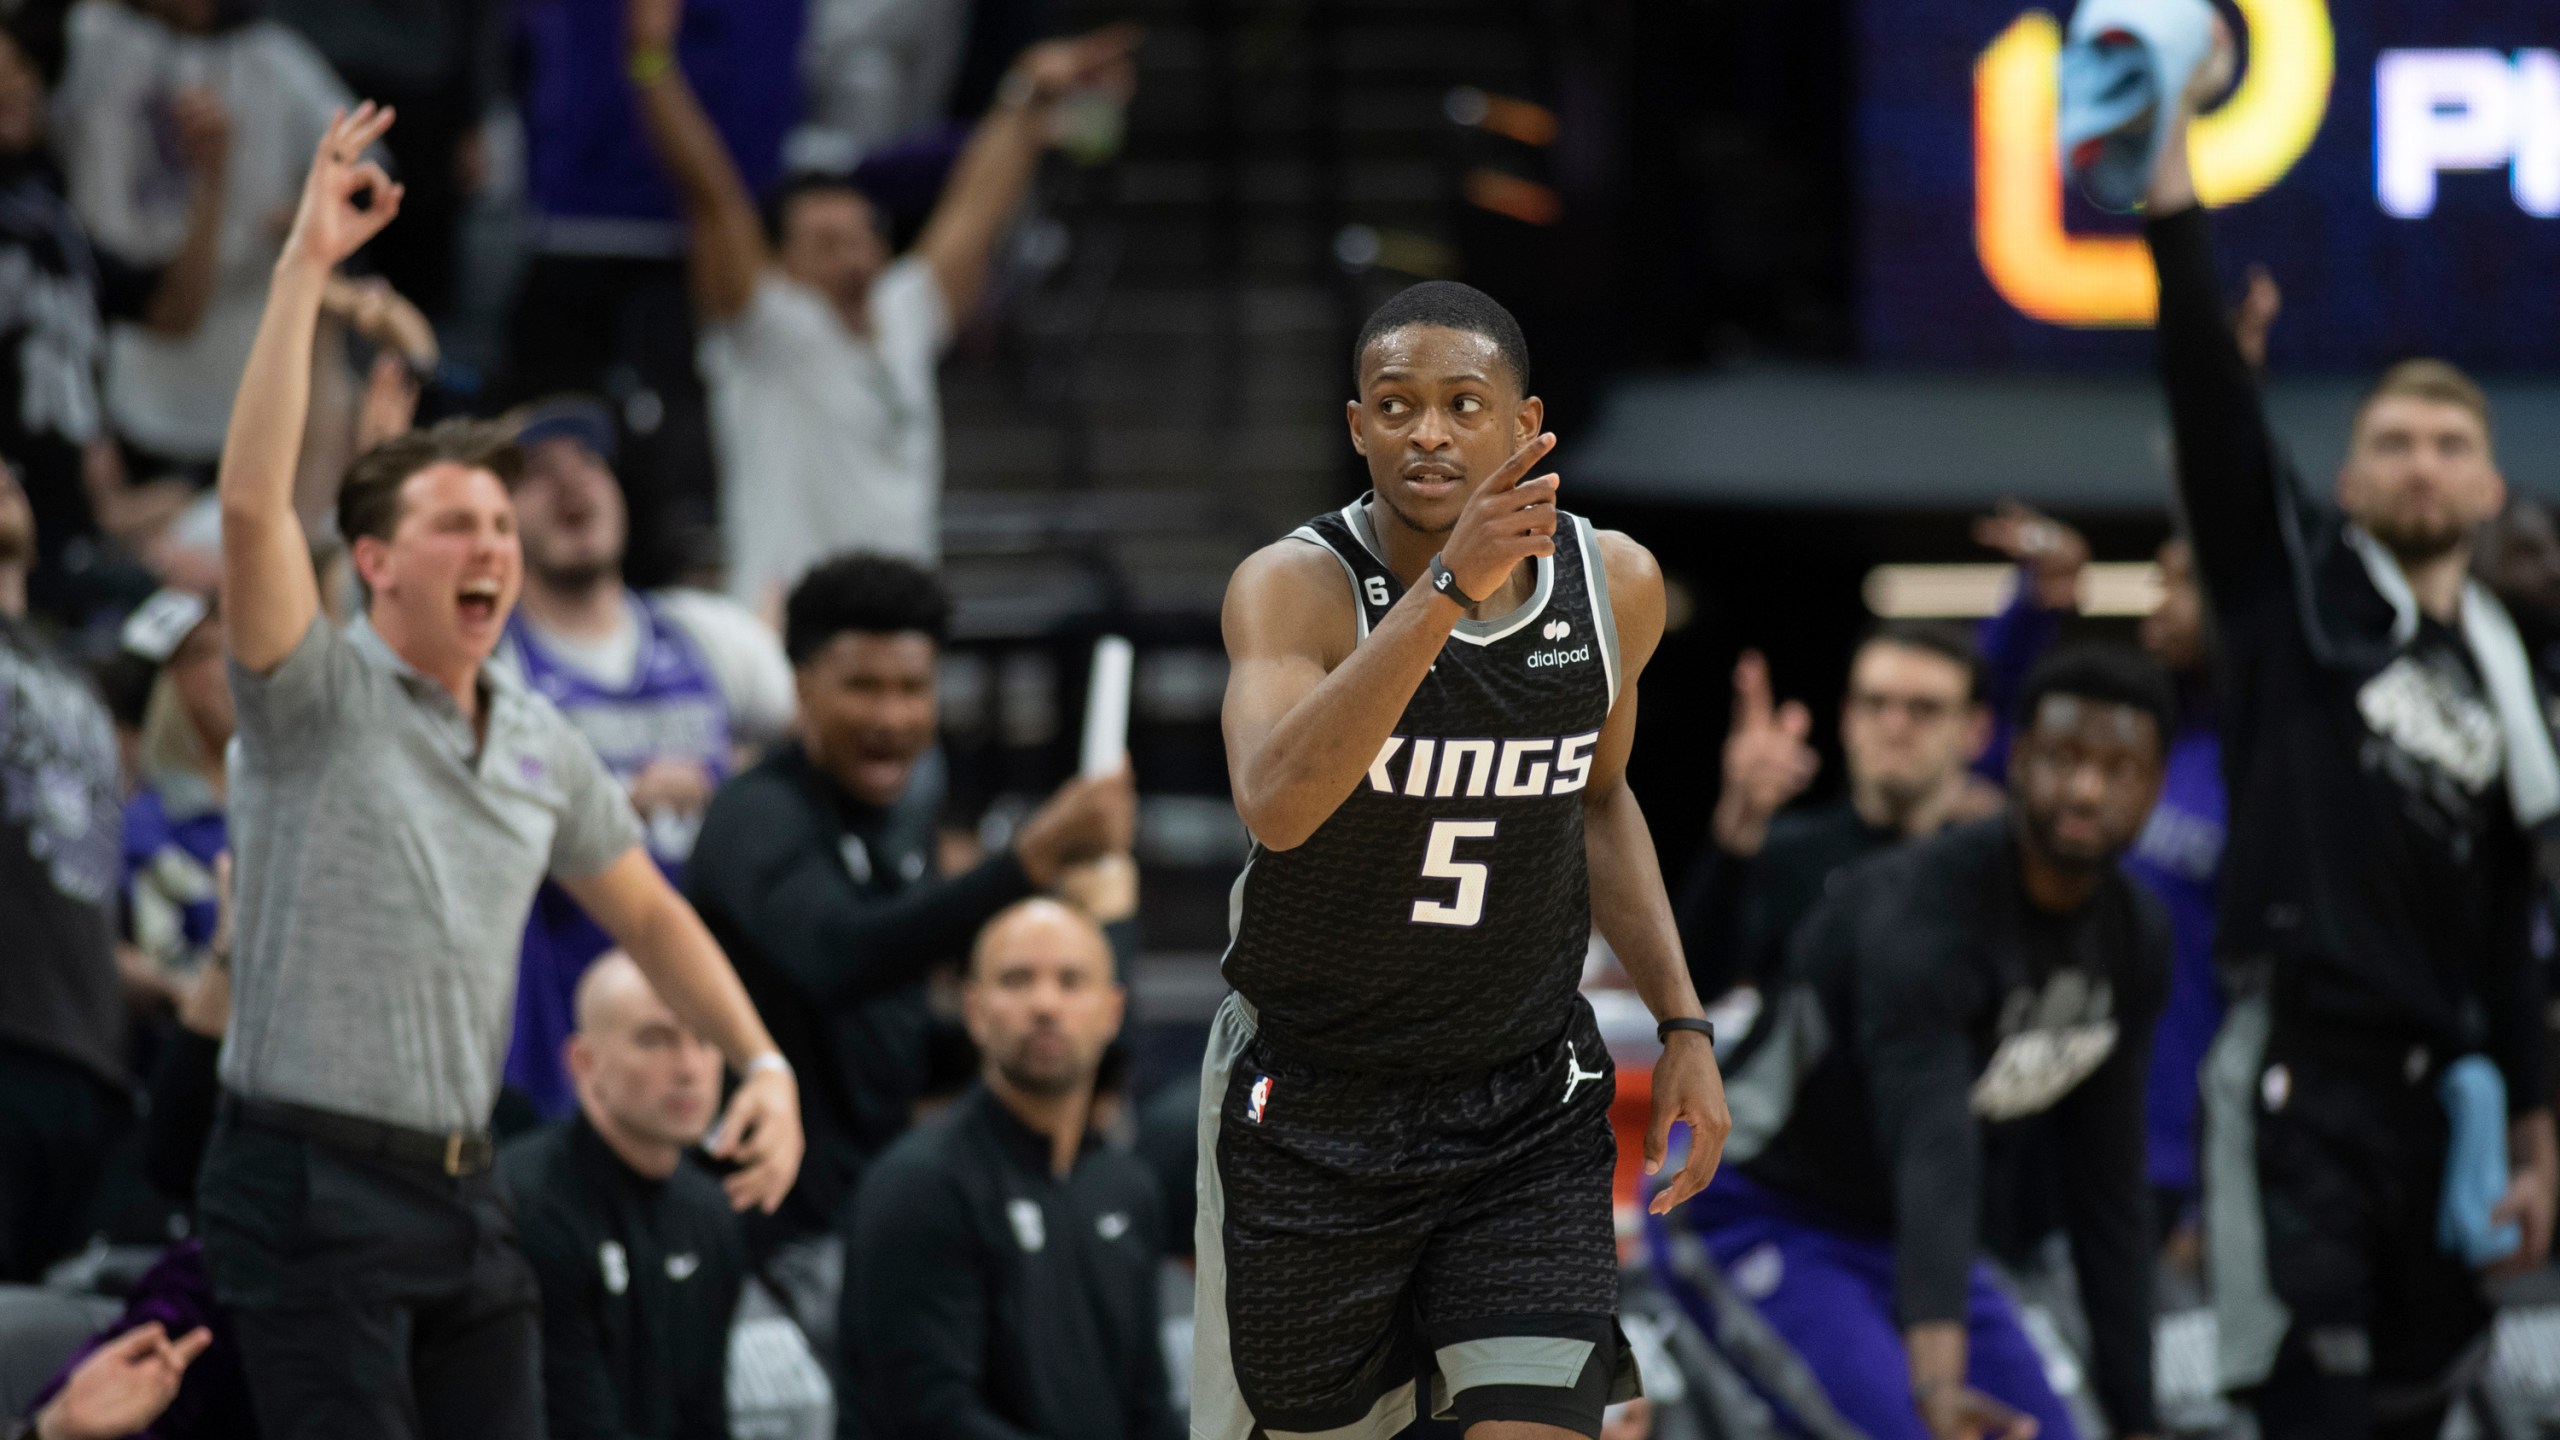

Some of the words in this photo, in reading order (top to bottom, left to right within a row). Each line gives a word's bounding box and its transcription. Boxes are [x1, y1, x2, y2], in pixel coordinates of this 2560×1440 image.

[1364, 575, 1390, 606] 6
[1527, 644, 1590, 669] dialpad
[1410, 819, 1497, 927] 5
